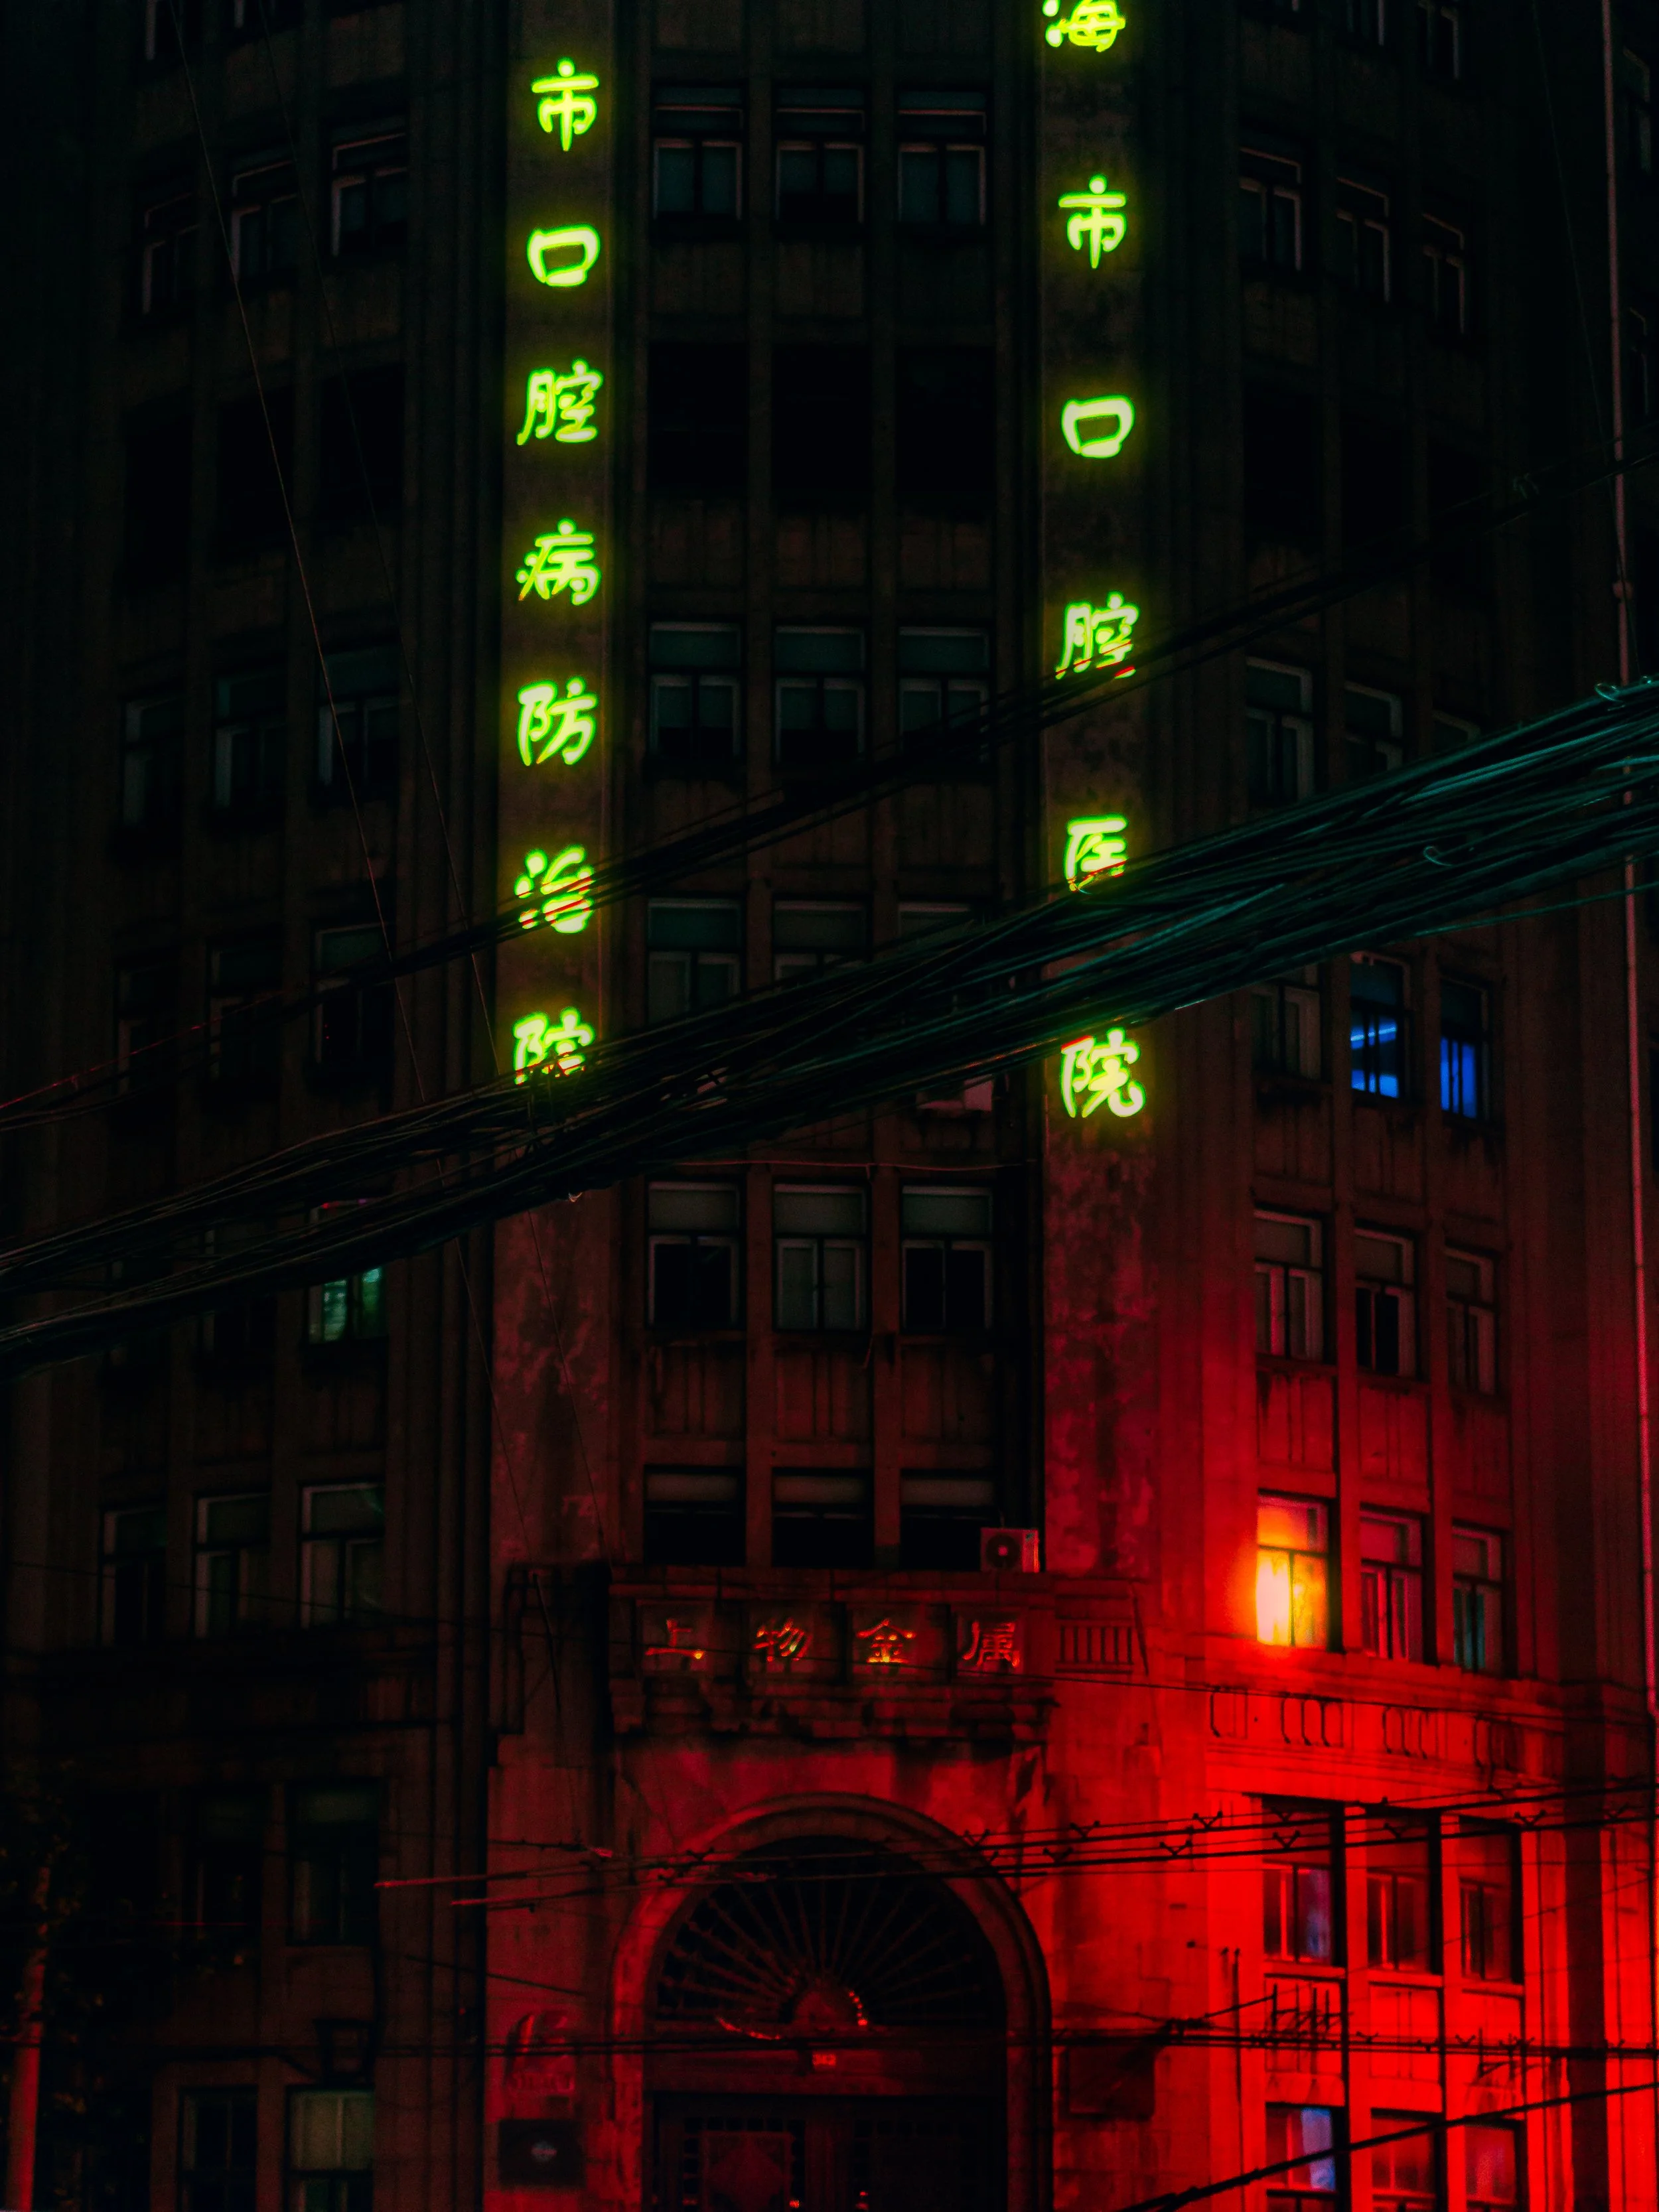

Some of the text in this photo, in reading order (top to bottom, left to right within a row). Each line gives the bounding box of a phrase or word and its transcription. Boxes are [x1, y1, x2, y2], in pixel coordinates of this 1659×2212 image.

[513, 58, 603, 1085] 市口腔病防治院
[1042, 0, 1146, 1118] 海市口腔医院
[644, 1618, 1021, 1668] 上物金属
